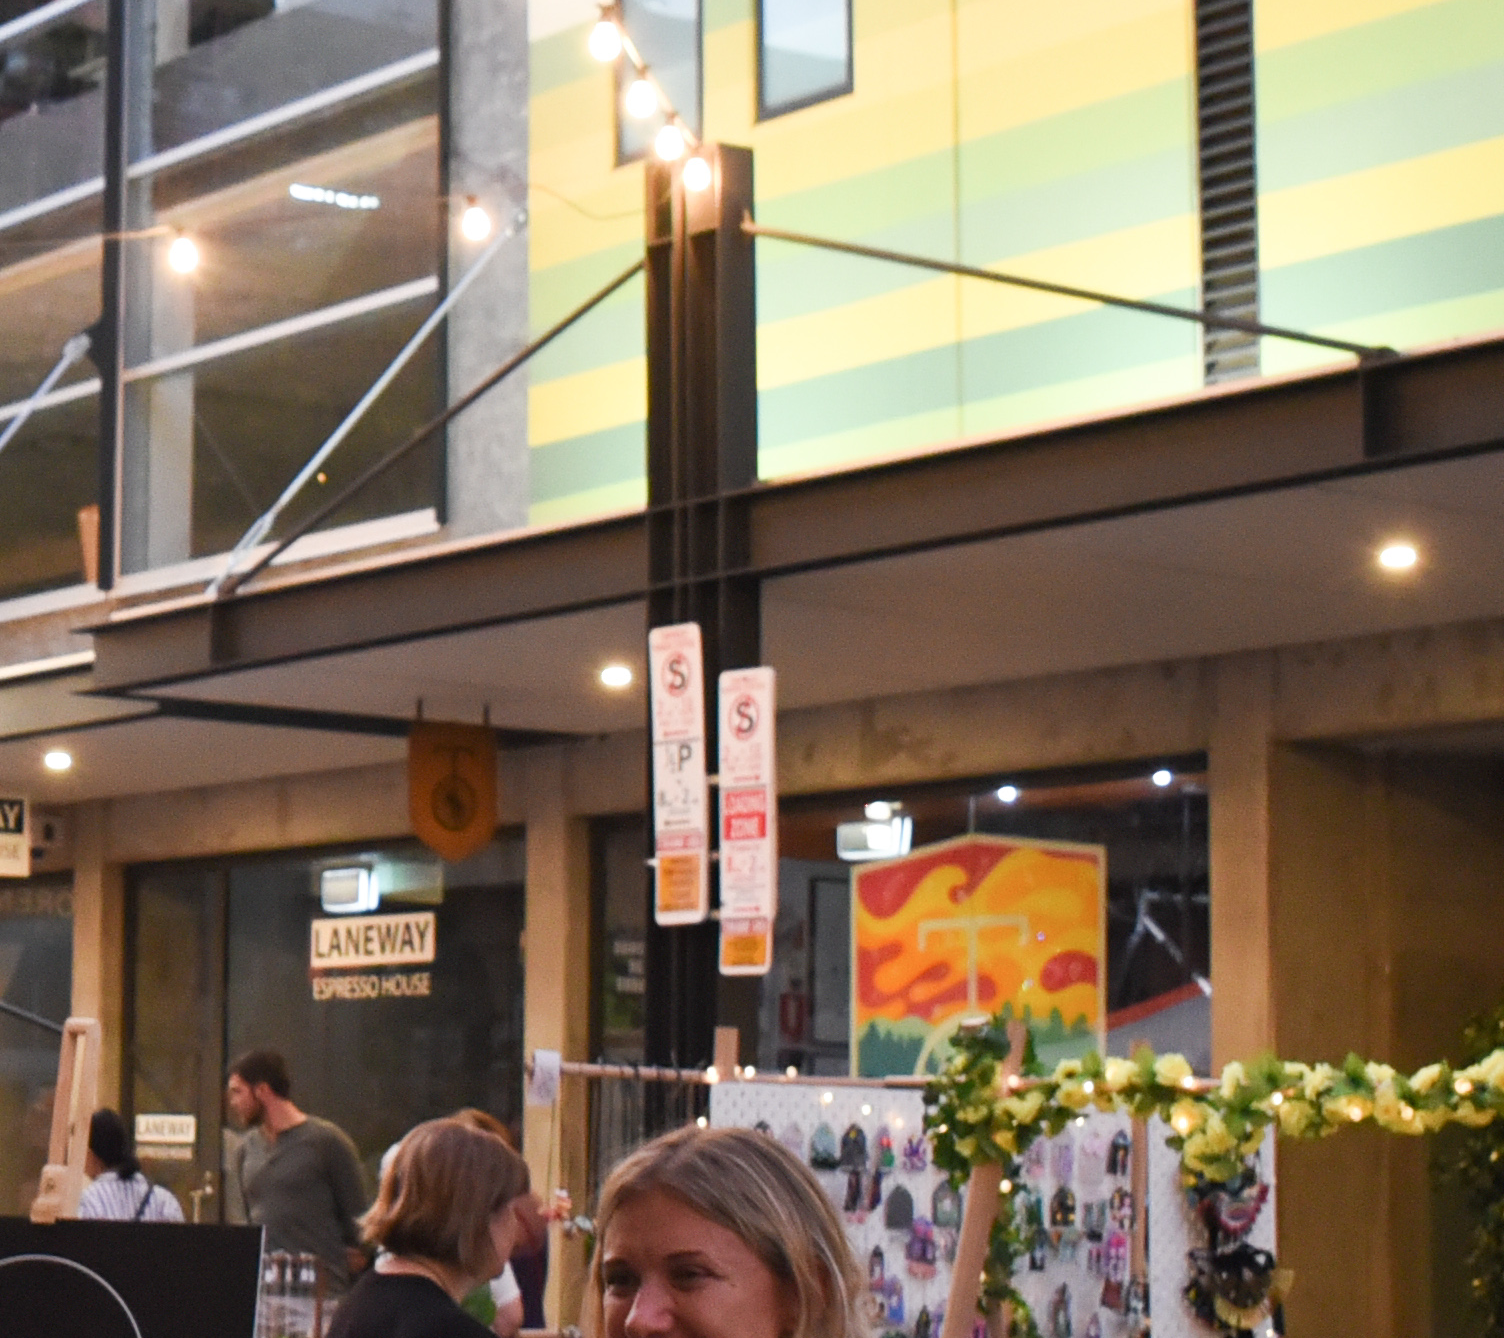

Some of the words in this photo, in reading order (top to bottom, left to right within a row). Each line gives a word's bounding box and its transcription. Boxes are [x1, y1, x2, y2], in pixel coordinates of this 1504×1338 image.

[313, 919, 430, 959] LANEWAY
[312, 974, 381, 1001] ESPRESSO
[382, 971, 431, 996] HOUSE
